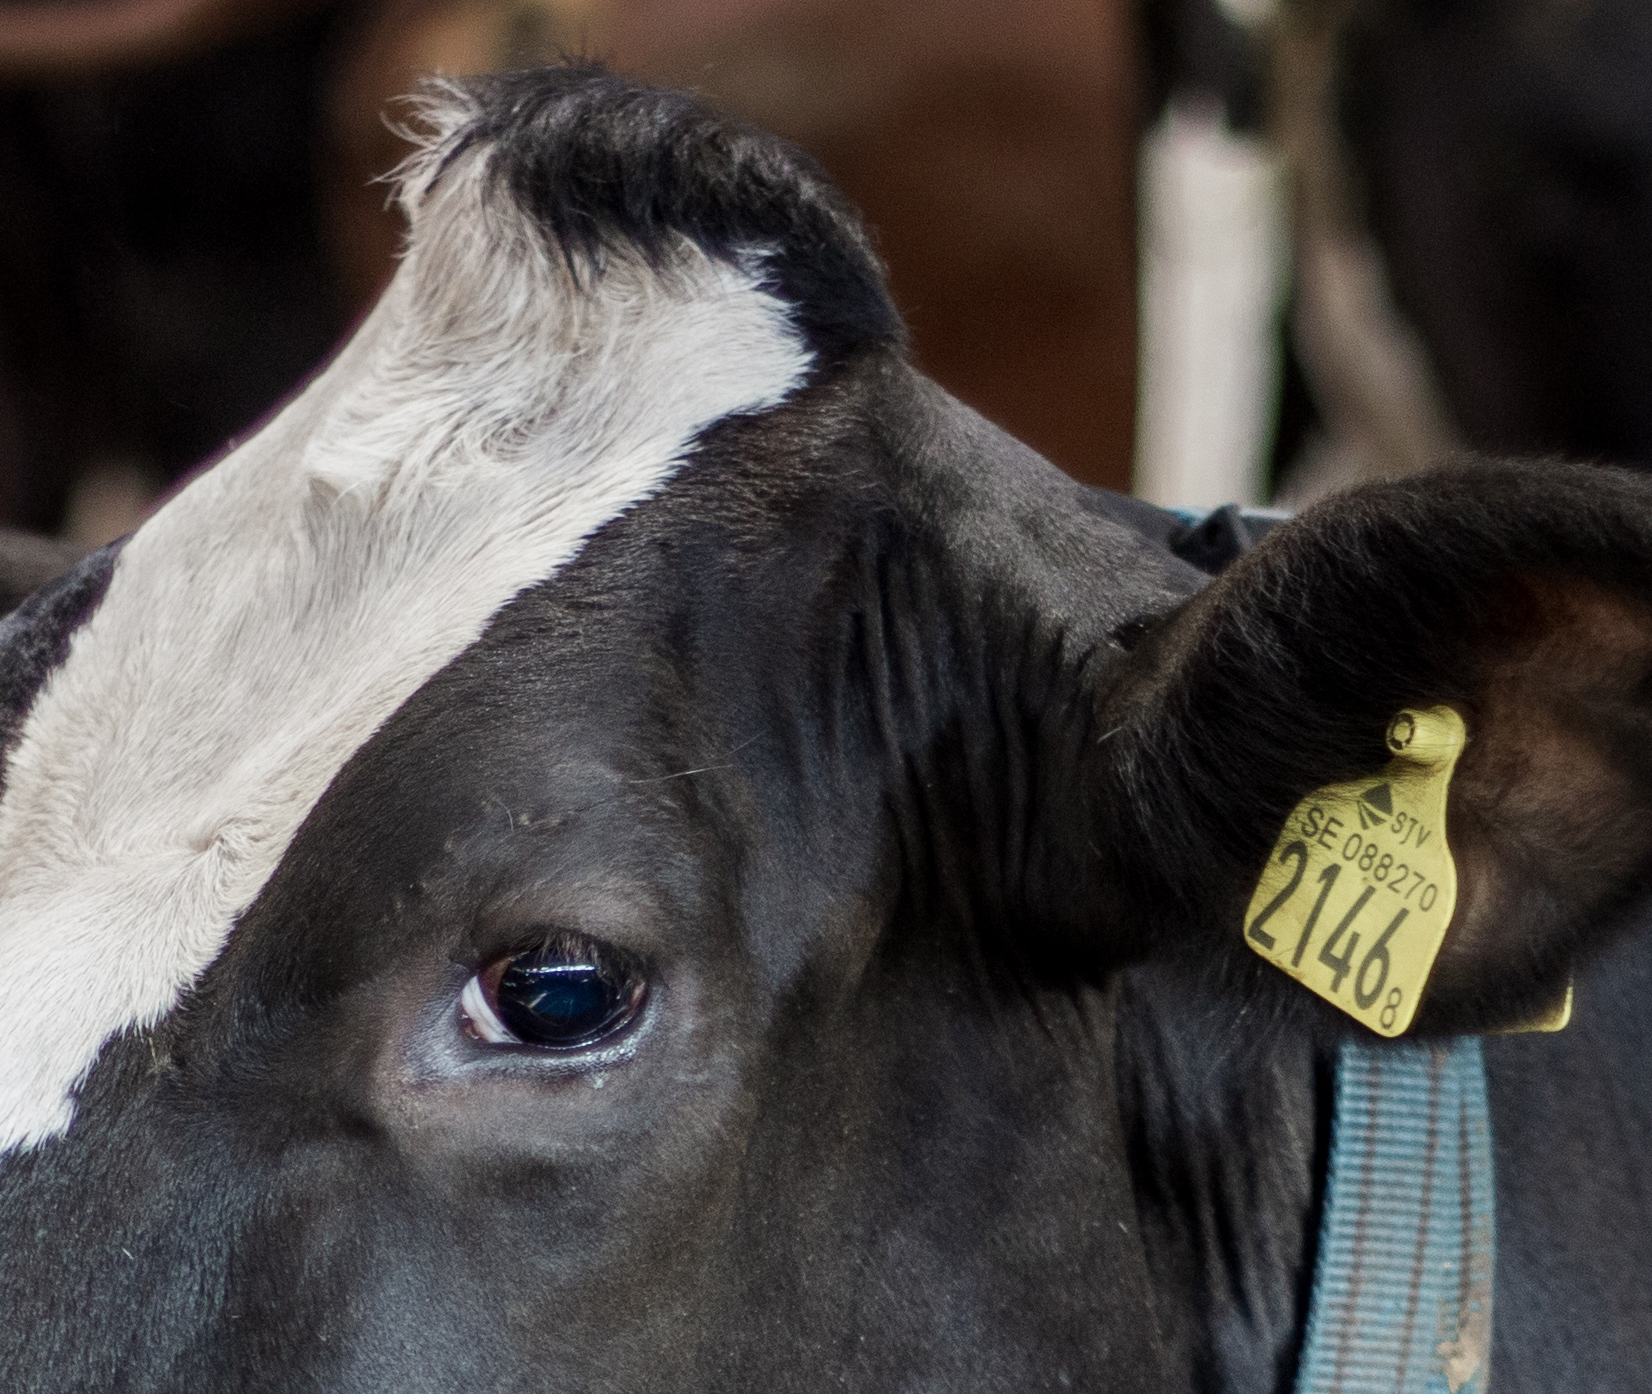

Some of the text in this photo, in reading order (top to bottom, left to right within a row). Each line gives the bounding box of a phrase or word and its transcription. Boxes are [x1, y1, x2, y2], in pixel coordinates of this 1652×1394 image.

[1301, 806, 1438, 912] SE 088270
[1247, 840, 1410, 1011] 2146
[1379, 987, 1403, 1030] 8
